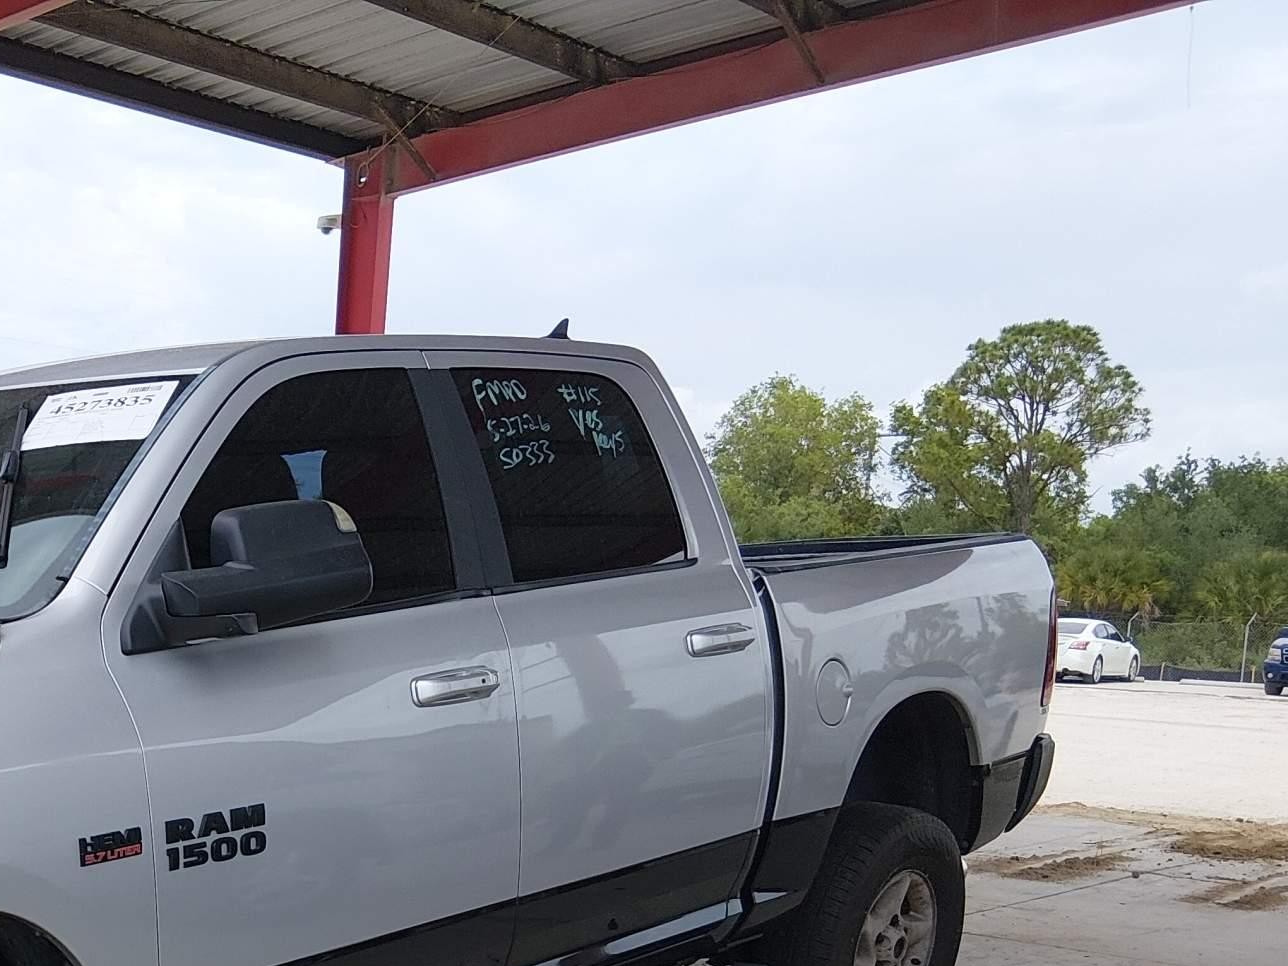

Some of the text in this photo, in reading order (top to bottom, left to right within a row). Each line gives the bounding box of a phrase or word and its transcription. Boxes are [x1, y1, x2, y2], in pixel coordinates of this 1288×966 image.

[49, 394, 156, 415] 45273835
[165, 803, 266, 844] RAM
[78, 826, 143, 853] HEMI
[107, 843, 142, 861] LITER
[166, 830, 267, 872] 1500
